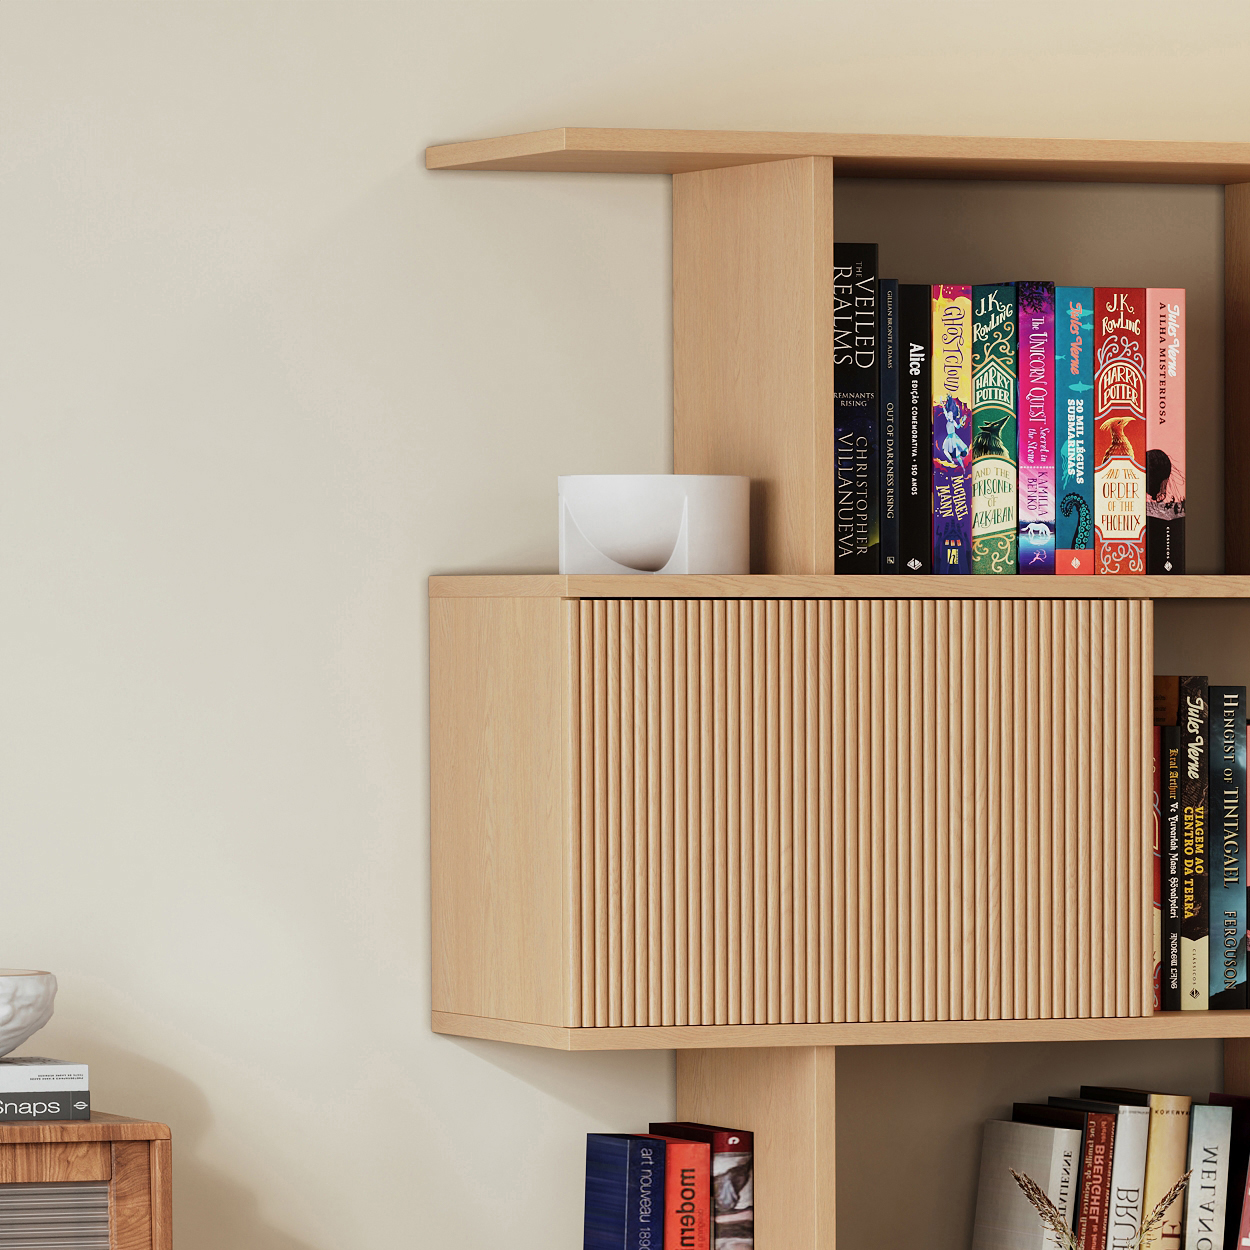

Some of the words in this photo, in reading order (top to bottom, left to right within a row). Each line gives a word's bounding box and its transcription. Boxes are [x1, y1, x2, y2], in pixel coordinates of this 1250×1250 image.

[834, 266, 852, 365] REALMS
[1070, 301, 1082, 335] Jules
[1160, 302, 1166, 310] A
[1168, 304, 1179, 336] Jules
[855, 276, 874, 368] VEILED
[1031, 317, 1044, 330] The
[910, 343, 925, 375] Alice
[1029, 332, 1047, 385] UNICORN
[1070, 337, 1082, 375] Verne
[1168, 339, 1180, 377] Verne
[975, 367, 1010, 389] HARRY
[1104, 366, 1138, 388] HARRY
[976, 387, 1010, 403] POTTER
[1026, 387, 1048, 423] QUEST
[1075, 399, 1084, 413] 20
[1104, 385, 1138, 406] POTTER
[887, 425, 894, 437] OF
[1029, 429, 1037, 439] the
[1039, 427, 1050, 452] Secret
[1075, 415, 1084, 436] MIL
[1028, 441, 1038, 463] Stone
[1076, 439, 1085, 484] LÉGUAS
[973, 479, 1013, 497] PRISONER
[975, 467, 991, 480] AND
[995, 467, 1010, 479] THE
[1102, 468, 1120, 480] AND
[1124, 469, 1139, 479] THE
[838, 432, 854, 557] VILLANUEVA
[856, 436, 867, 555] CHRISTOPHER
[936, 485, 954, 518] MANN
[951, 475, 968, 521] MICHAEL
[1027, 478, 1037, 510] BENKO
[1038, 472, 1048, 516] KAMILLA
[1102, 482, 1139, 500] ORDER
[1108, 501, 1116, 511] OF
[1120, 501, 1134, 511] THE
[973, 506, 1013, 529] AZKABAN
[1102, 514, 1140, 531] PHOENIX
[1187, 697, 1204, 733] Jules
[1223, 694, 1239, 763] HENGIST
[1169, 748, 1178, 769] Kral
[1188, 736, 1204, 779] Verne
[1168, 771, 1178, 799] Arthur
[1184, 806, 1193, 855] CENTRO
[1195, 806, 1204, 854] VIAGEM
[1223, 787, 1239, 889] TINTAGAEL
[1169, 853, 1178, 874] Masa
[1184, 860, 1193, 875] DA
[1195, 857, 1204, 874] AO
[1184, 878, 1193, 919] TERRA
[1224, 910, 1237, 990] FERGUSON
[640, 1148, 654, 1166] art
[640, 1168, 652, 1223] nouveau
